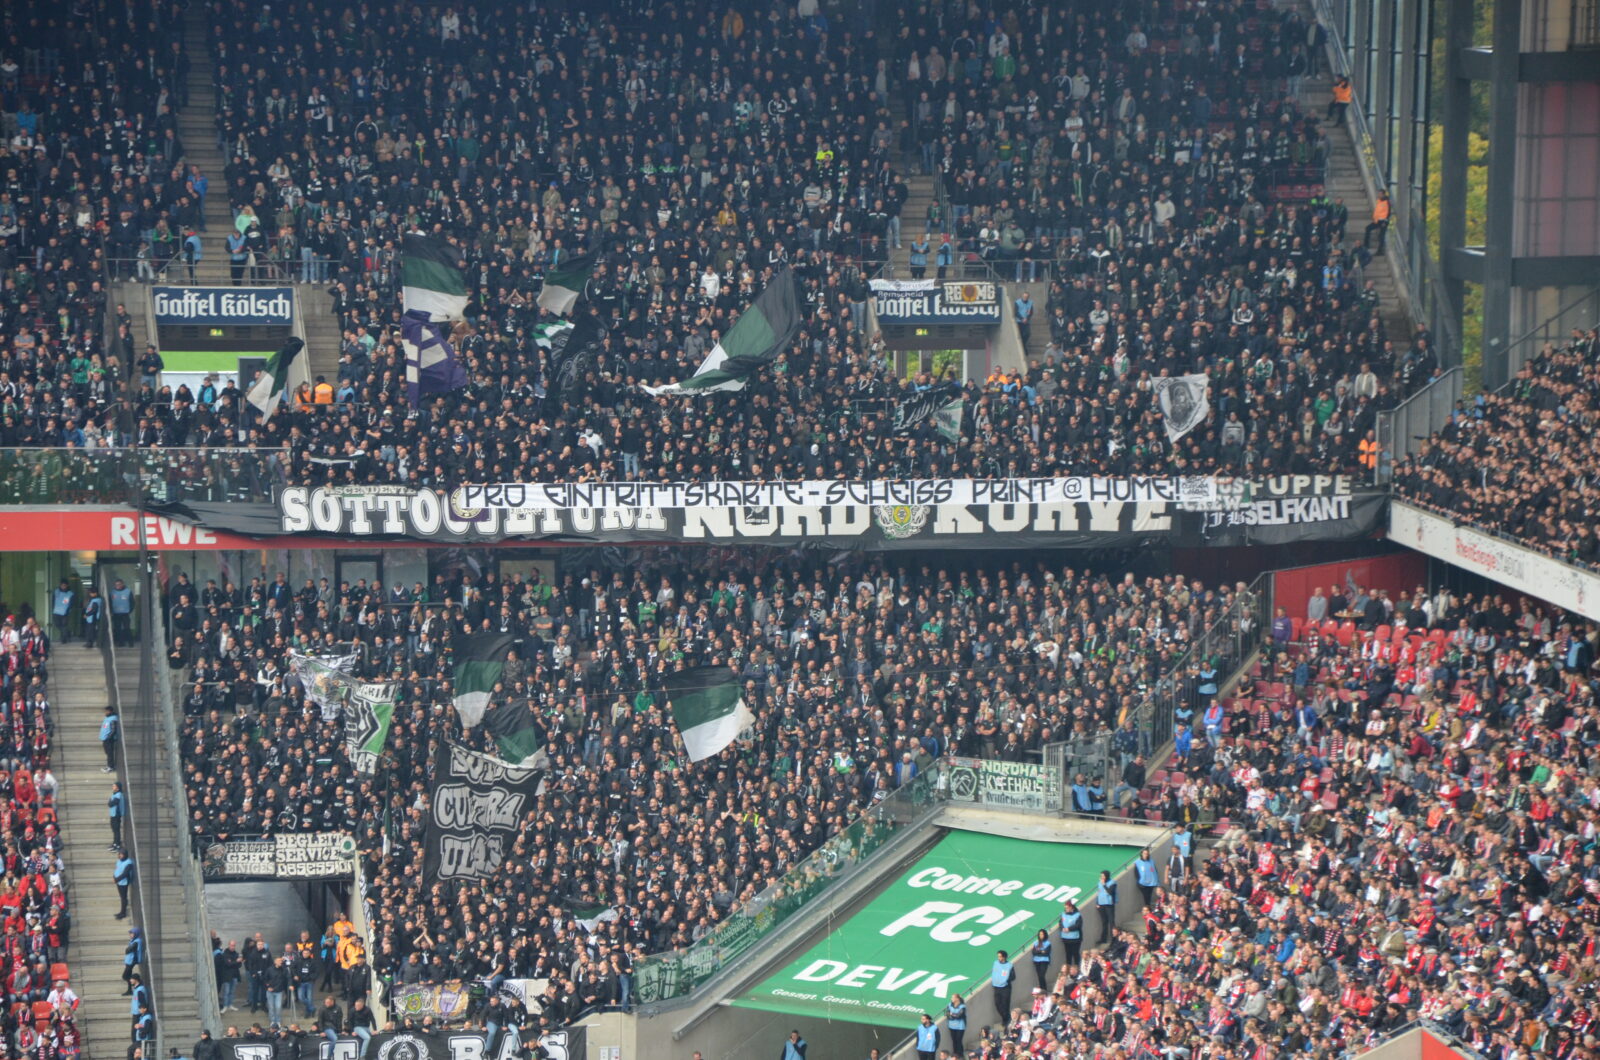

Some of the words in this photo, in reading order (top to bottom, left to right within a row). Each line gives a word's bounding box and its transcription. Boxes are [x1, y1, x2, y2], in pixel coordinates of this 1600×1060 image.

[155, 289, 217, 318] Gaffel
[221, 293, 291, 320] Kölsch
[877, 290, 924, 299] Remscheid
[465, 484, 526, 508] PRO
[1245, 495, 1352, 526] SELFKANT
[111, 516, 217, 546] REWE
[275, 833, 342, 849] BEGLEIT
[226, 852, 274, 862] GEHT
[275, 847, 341, 862] SERVICE
[224, 862, 275, 874] EINIGES
[907, 867, 1024, 897] Come
[879, 901, 1035, 947] FC!
[792, 959, 969, 999] DEVK
[771, 988, 817, 1001] Gesagt.
[822, 994, 862, 1006] Getan.
[866, 1000, 926, 1014] Geholfen.
